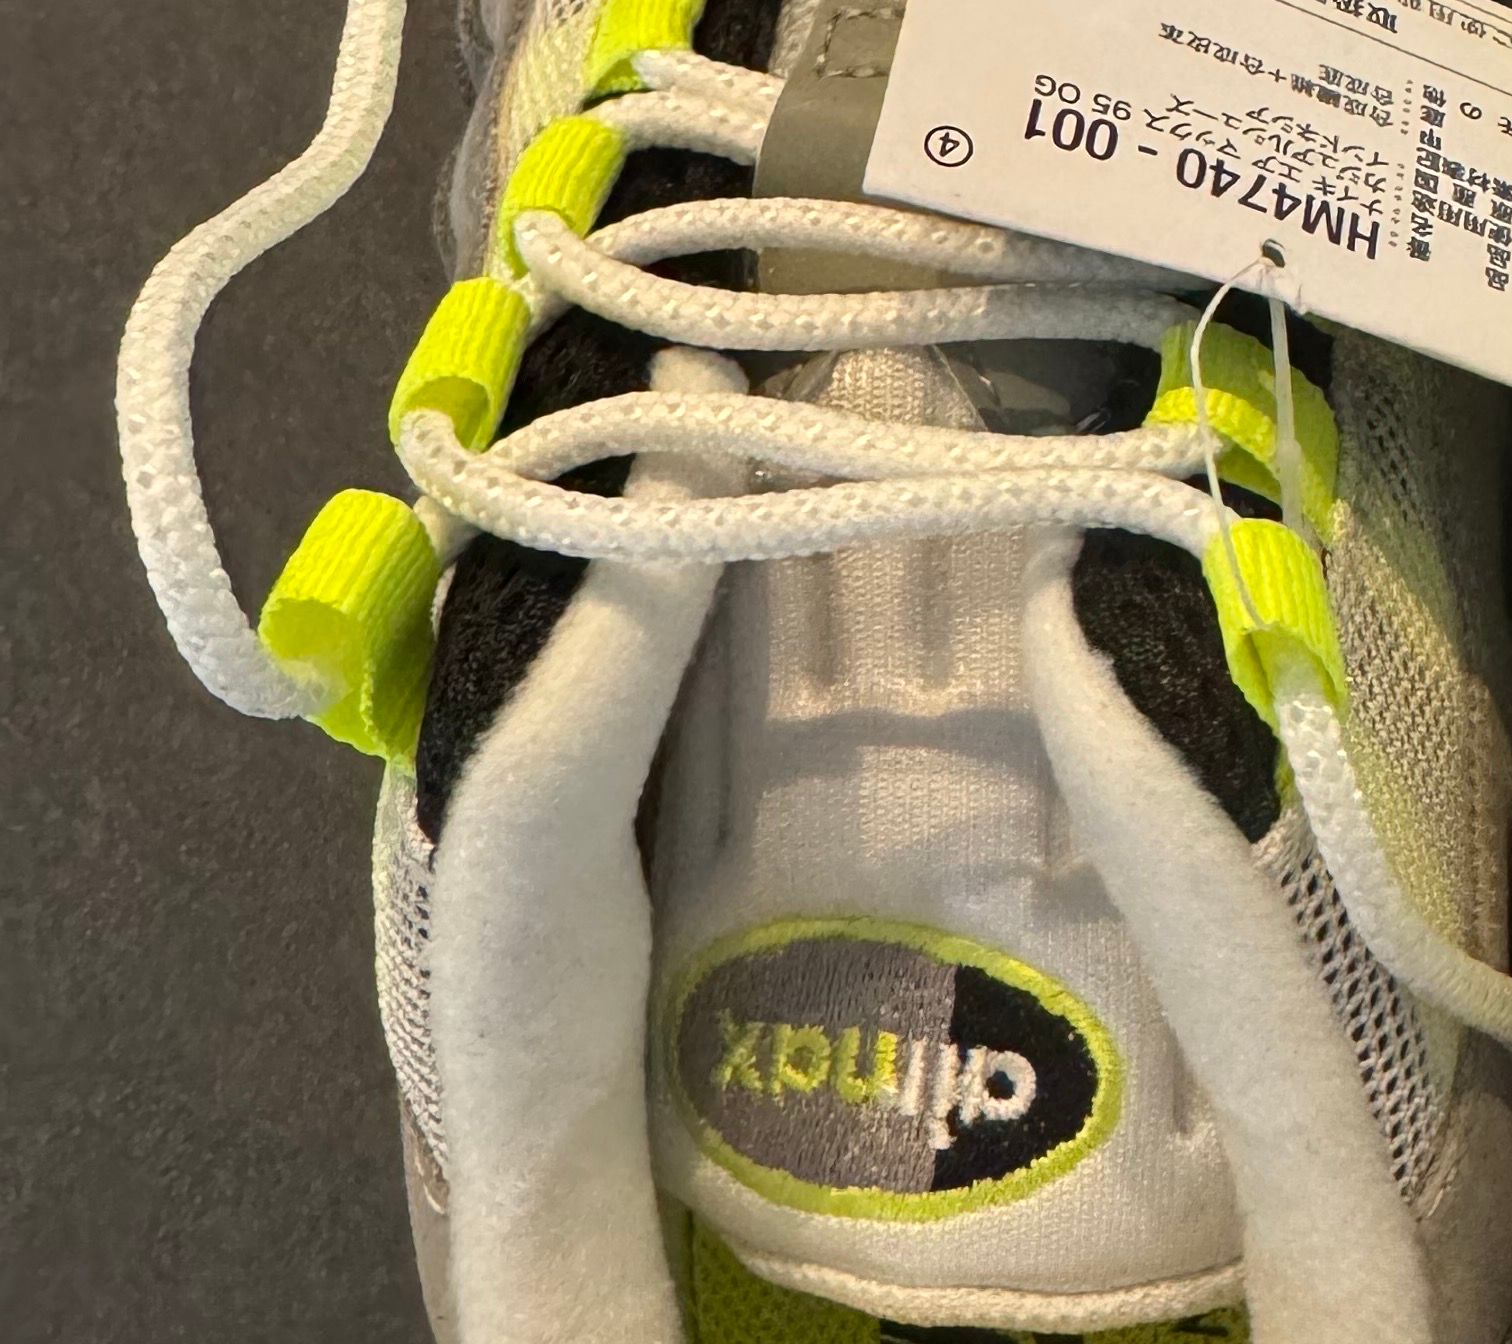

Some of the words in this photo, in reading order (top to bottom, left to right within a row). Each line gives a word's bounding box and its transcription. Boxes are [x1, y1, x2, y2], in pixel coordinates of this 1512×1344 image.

[1034, 74, 1081, 105] OG
[1091, 92, 1133, 121] 95
[1023, 97, 1119, 162] 001
[1142, 108, 1242, 160] マックス
[1164, 93, 1387, 194] カジュアルシューズ
[1244, 106, 1390, 167] インドネシア
[1250, 155, 1304, 184] エア
[1311, 175, 1384, 216] ナイキ
[1175, 147, 1381, 261] HM4740
[714, 1008, 1039, 1151] airmax
